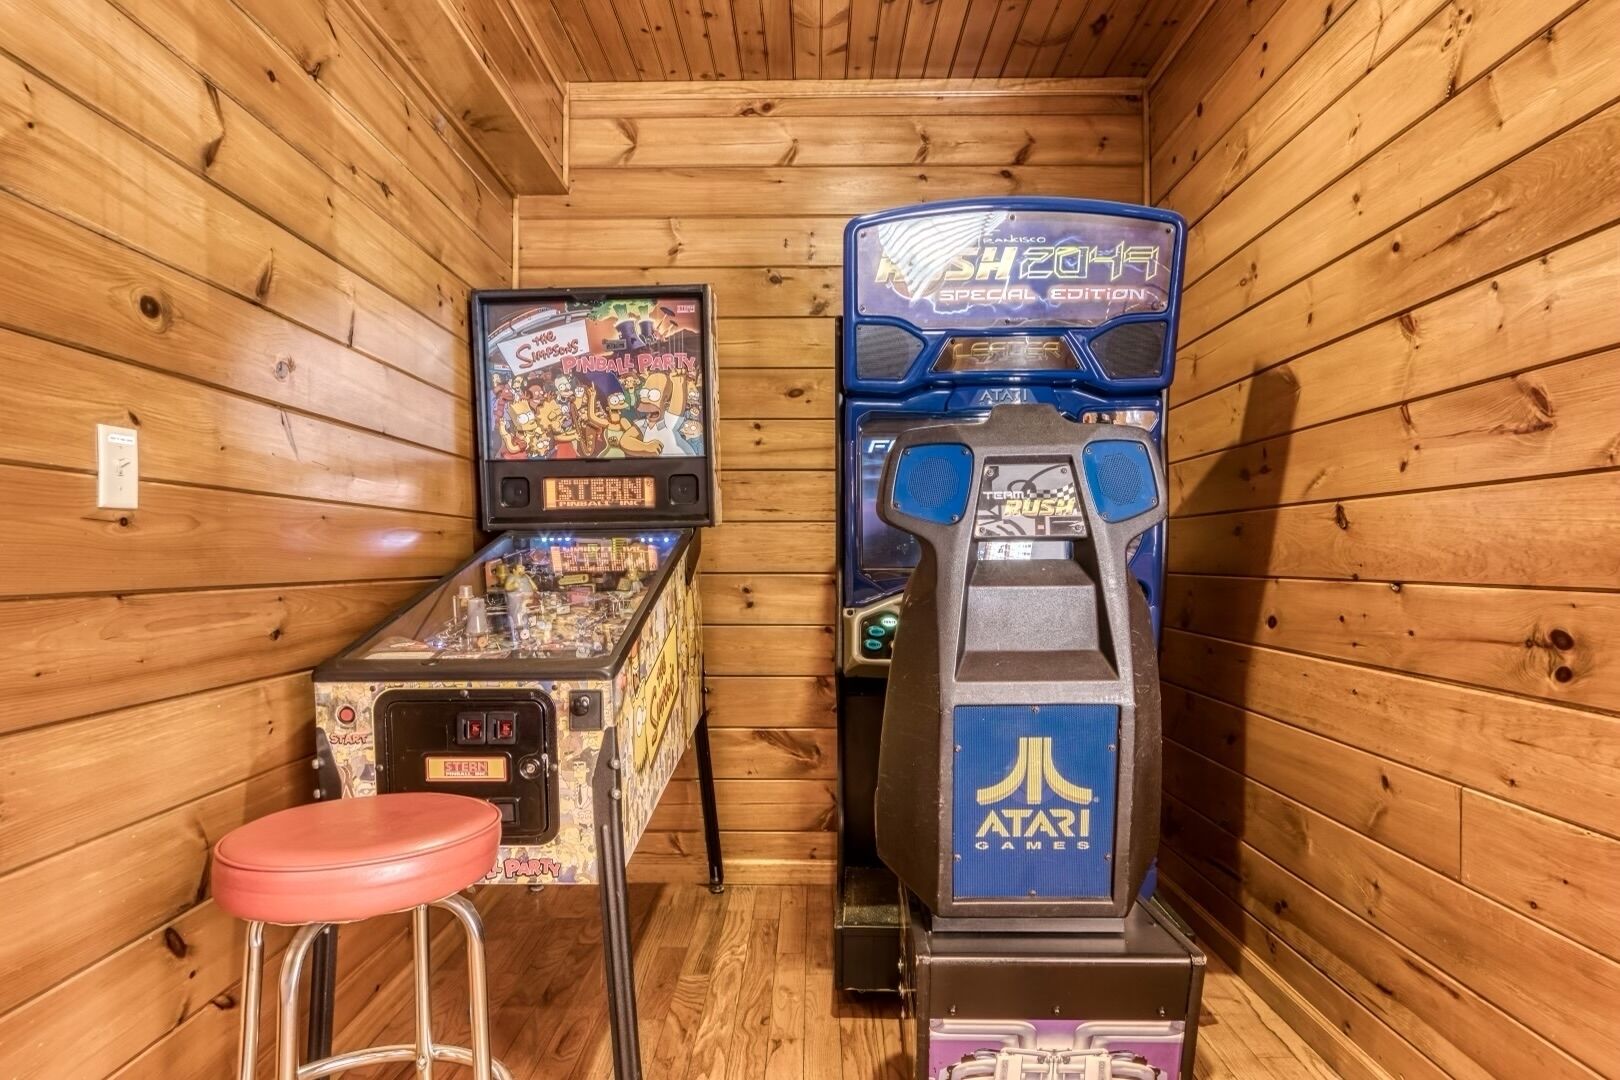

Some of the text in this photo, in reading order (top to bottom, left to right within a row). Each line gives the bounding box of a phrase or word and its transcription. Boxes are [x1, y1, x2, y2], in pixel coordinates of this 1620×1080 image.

[875, 241, 1160, 283] RSH 2049
[940, 288, 1036, 301] SPECIAL
[561, 352, 696, 375] PINBALL PARTY
[558, 478, 642, 500] STERN
[983, 491, 1025, 500] TEAM
[1004, 497, 1076, 517] RUSH
[329, 733, 368, 745] START
[445, 762, 488, 772] STERN
[975, 808, 1090, 838] ATARI
[975, 841, 1090, 850] GAMES
[504, 858, 561, 879] PARTY
